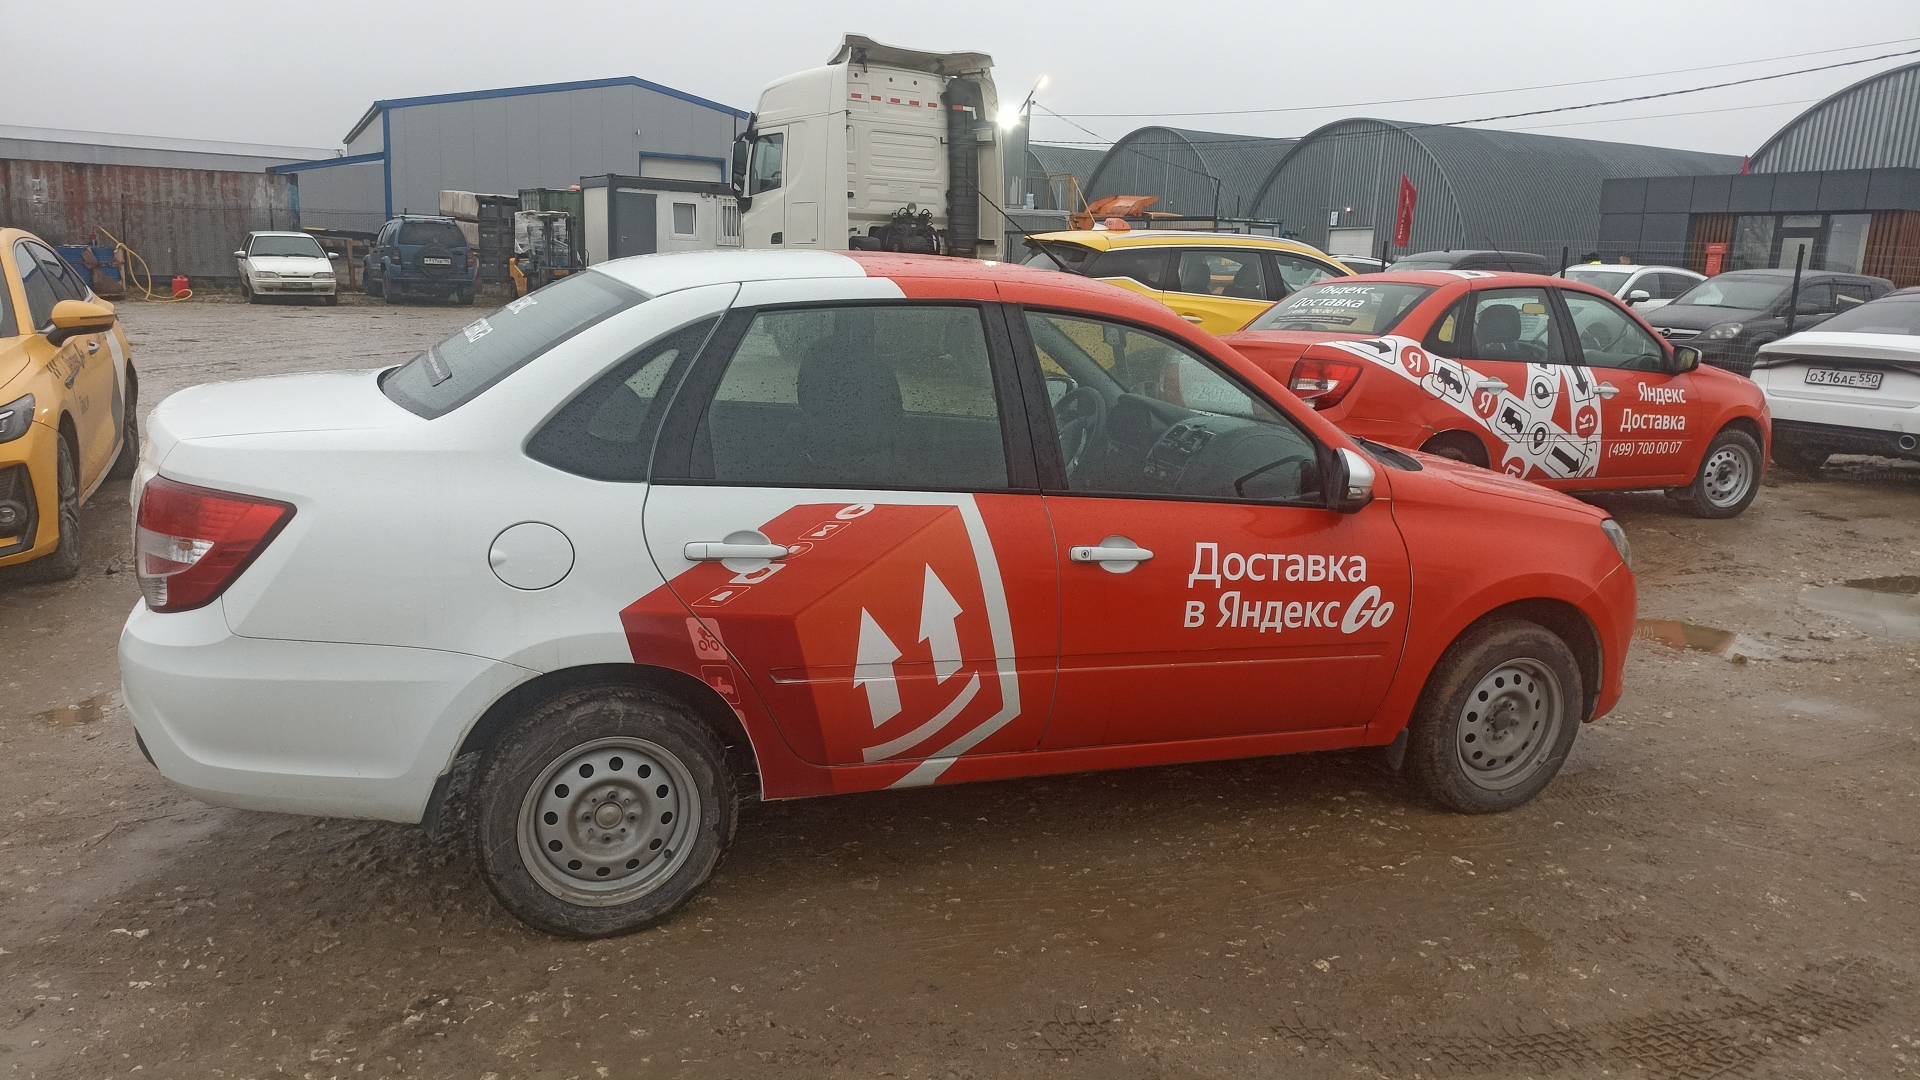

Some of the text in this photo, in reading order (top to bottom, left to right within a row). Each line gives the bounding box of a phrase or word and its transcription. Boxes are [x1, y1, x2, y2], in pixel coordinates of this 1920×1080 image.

[1317, 286, 1374, 295] Яндекс
[1288, 297, 1364, 308] Доставка
[1859, 373, 1879, 384] 550
[1637, 381, 1687, 406] Яндекс
[1620, 408, 1686, 433] Доставка
[1608, 441, 1682, 458] (499) 700 00 07
[1188, 542, 1367, 589] Доставка
[1184, 585, 1395, 634] в Яндекс Go
